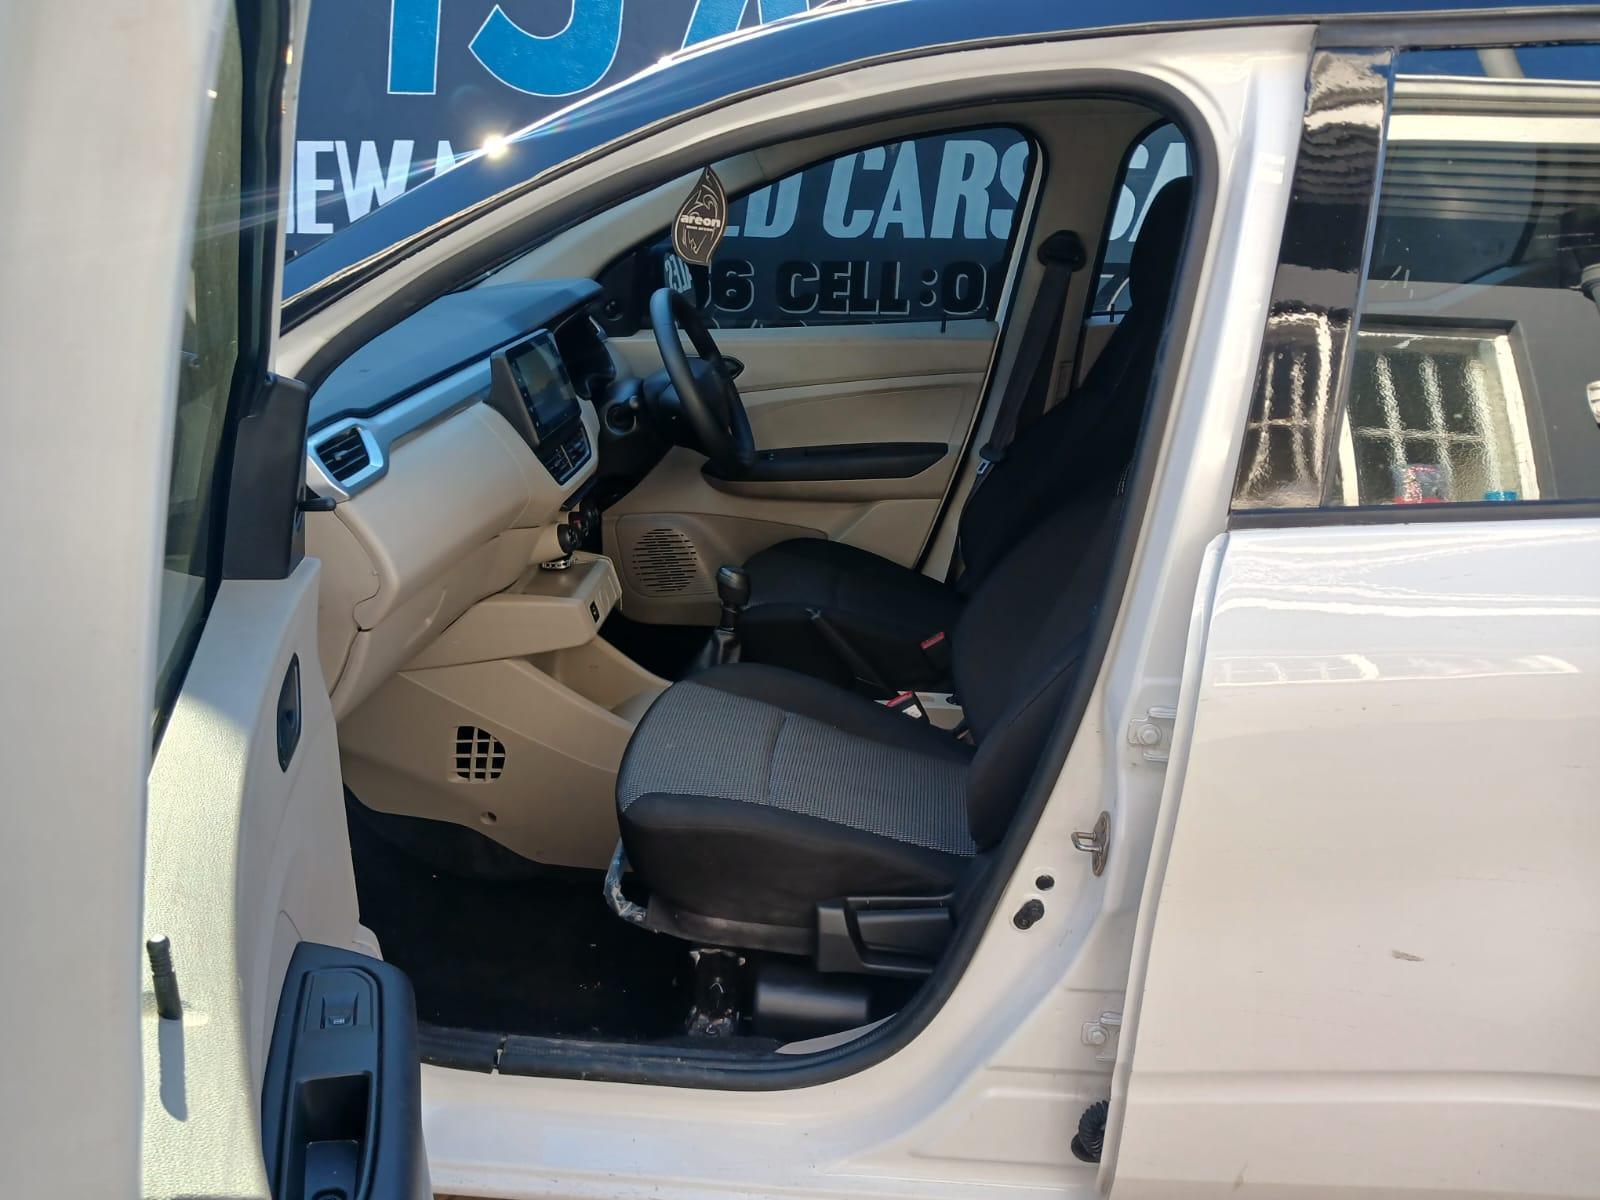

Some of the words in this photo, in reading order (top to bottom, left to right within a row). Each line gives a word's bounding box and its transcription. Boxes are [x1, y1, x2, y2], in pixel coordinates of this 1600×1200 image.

[285, 140, 415, 234] EW
[823, 140, 1029, 240] CARS
[680, 214, 721, 228] areon
[775, 260, 910, 315] CELL
